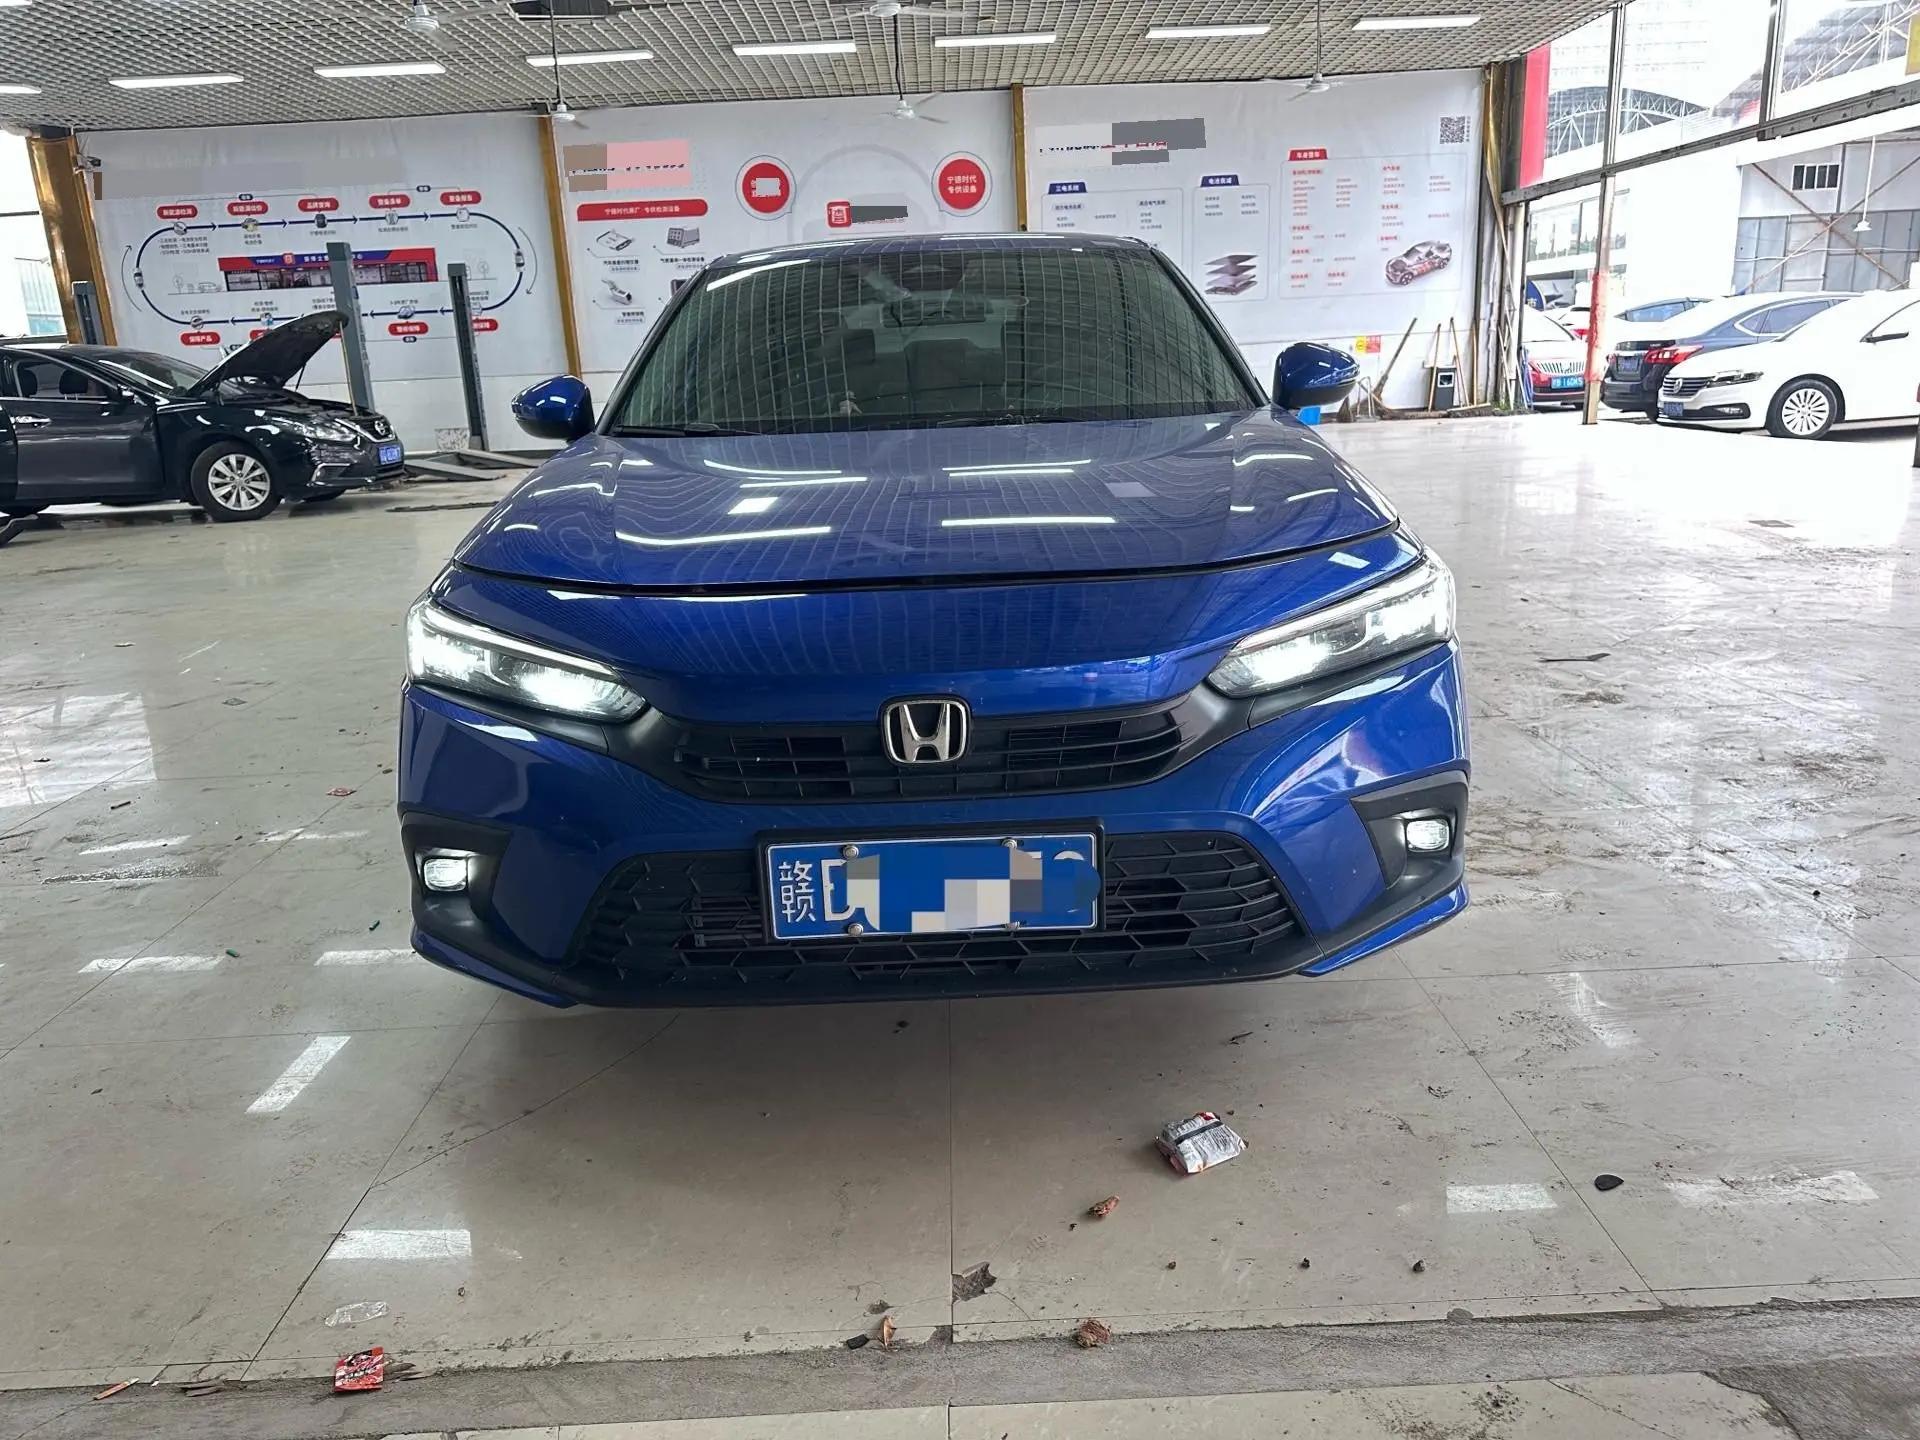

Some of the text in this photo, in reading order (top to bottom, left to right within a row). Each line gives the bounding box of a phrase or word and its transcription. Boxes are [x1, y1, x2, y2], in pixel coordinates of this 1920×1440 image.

[947, 175, 977, 184] 宁德时代
[947, 185, 977, 194] 专供设备
